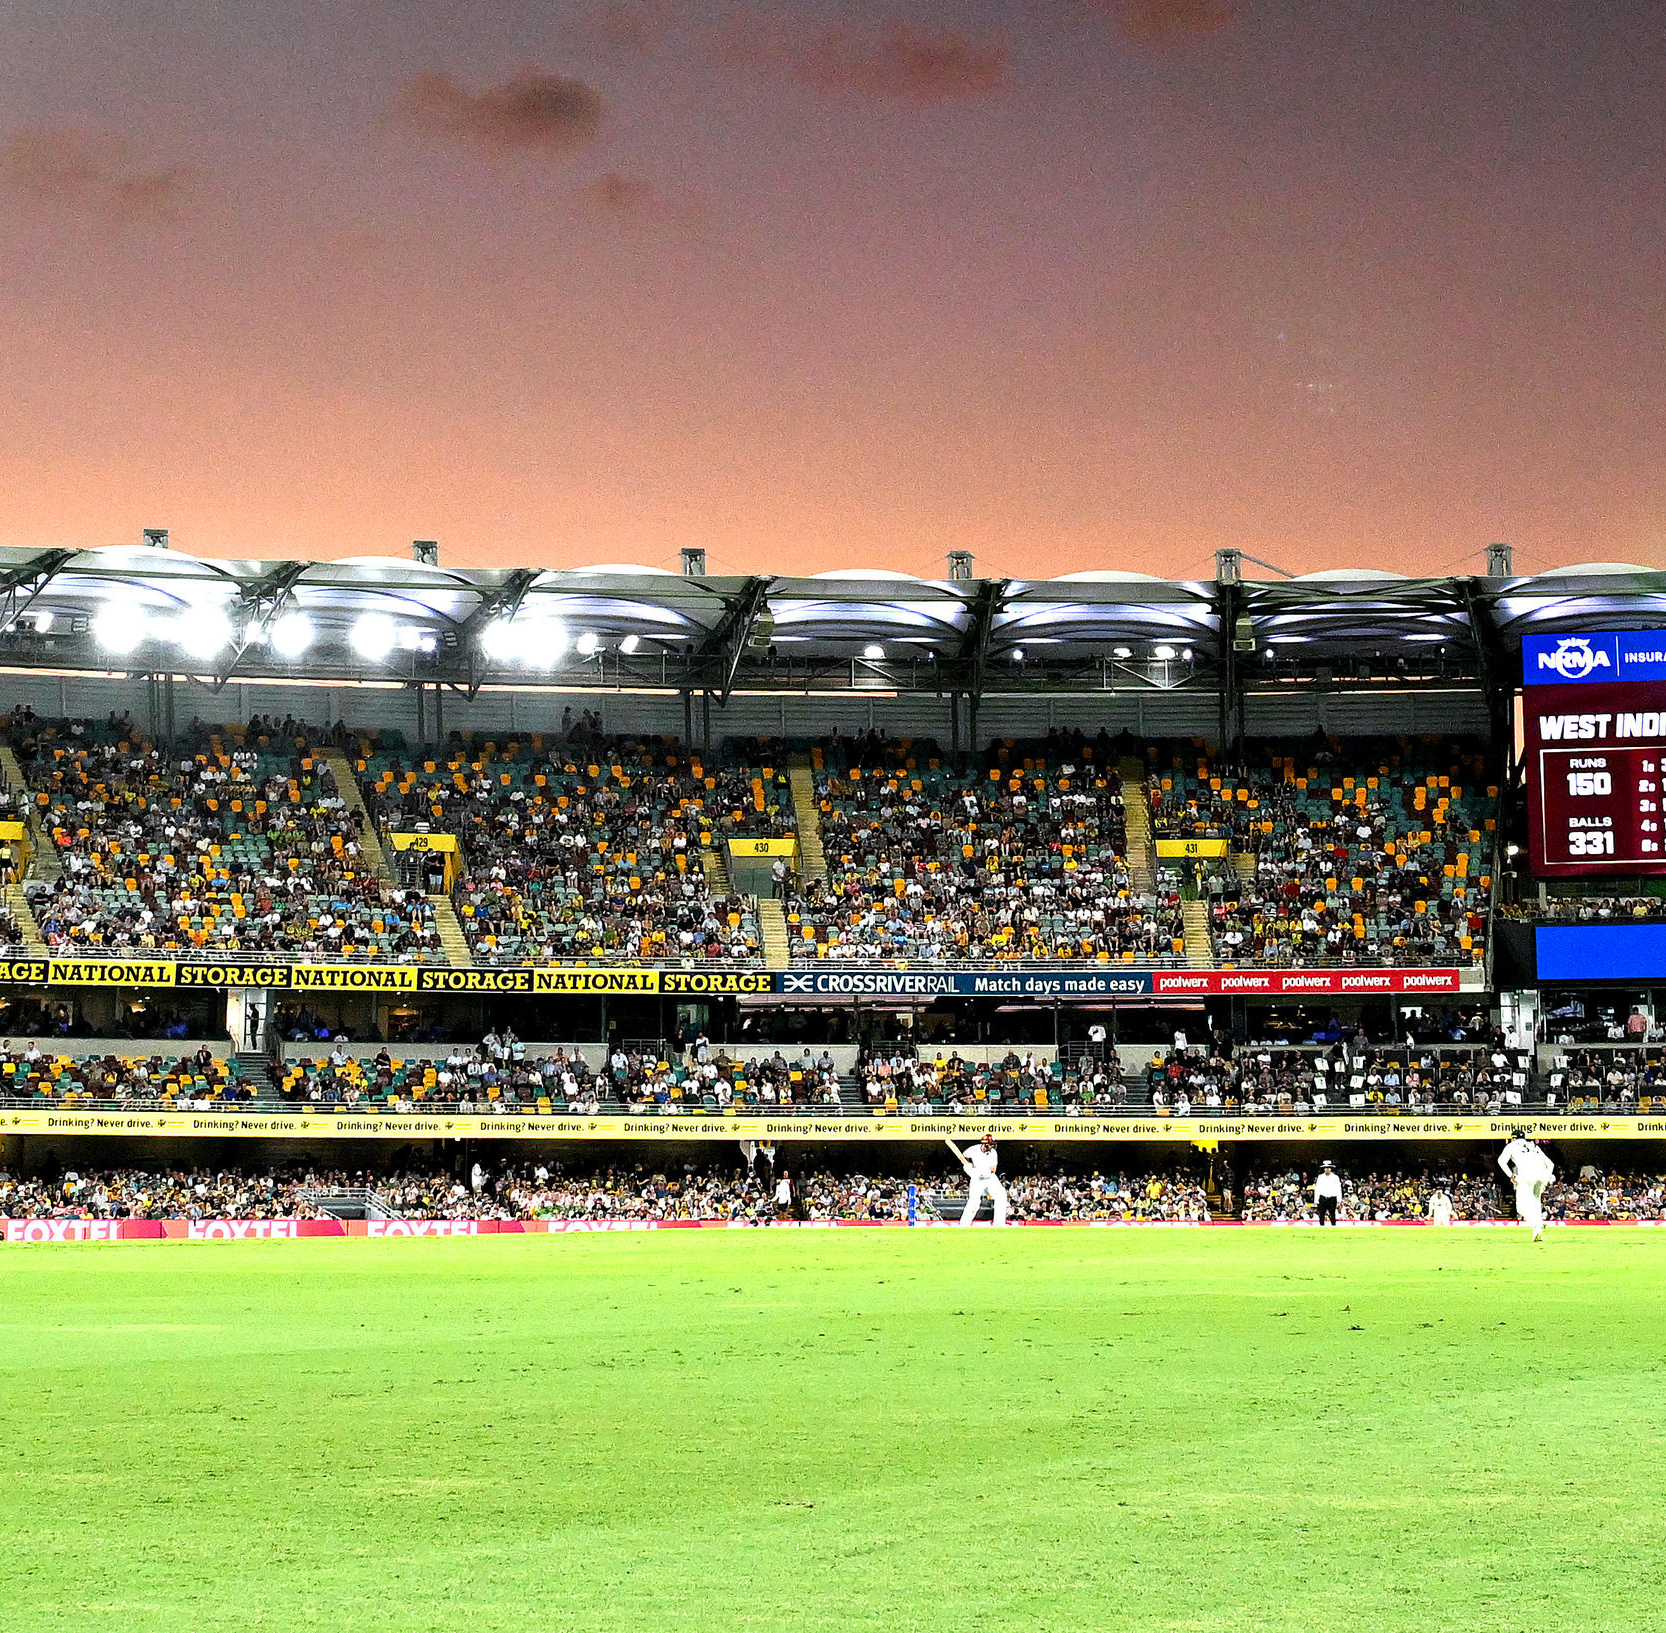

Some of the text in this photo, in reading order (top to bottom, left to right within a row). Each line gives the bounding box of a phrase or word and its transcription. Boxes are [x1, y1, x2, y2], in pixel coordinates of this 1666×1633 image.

[1538, 651, 1611, 668] NRMA
[1539, 714, 1611, 740] WEST
[1569, 758, 1607, 768] RUNS
[1566, 772, 1612, 796] 150
[1569, 817, 1612, 827] BALLS
[414, 837, 428, 848] 429
[755, 842, 769, 853] 430
[1185, 843, 1198, 854] 431
[1568, 831, 1614, 855] 331
[51, 964, 288, 987] NATIONAL STORAGE
[294, 969, 529, 991] NATIONAL STORAGE
[537, 972, 771, 993] NATIONAL STORAGE
[1159, 974, 1208, 991] poolwerx
[1221, 974, 1270, 990] poolwerx
[1342, 973, 1391, 989] poolwerx
[1403, 972, 1452, 989] poolwerx
[975, 976, 1145, 995] Match days made easy
[480, 1122, 584, 1133] Drinking? Never drive.
[1054, 1124, 1159, 1136] Drinking? Never drive.
[7, 1220, 119, 1241] FOXTEL
